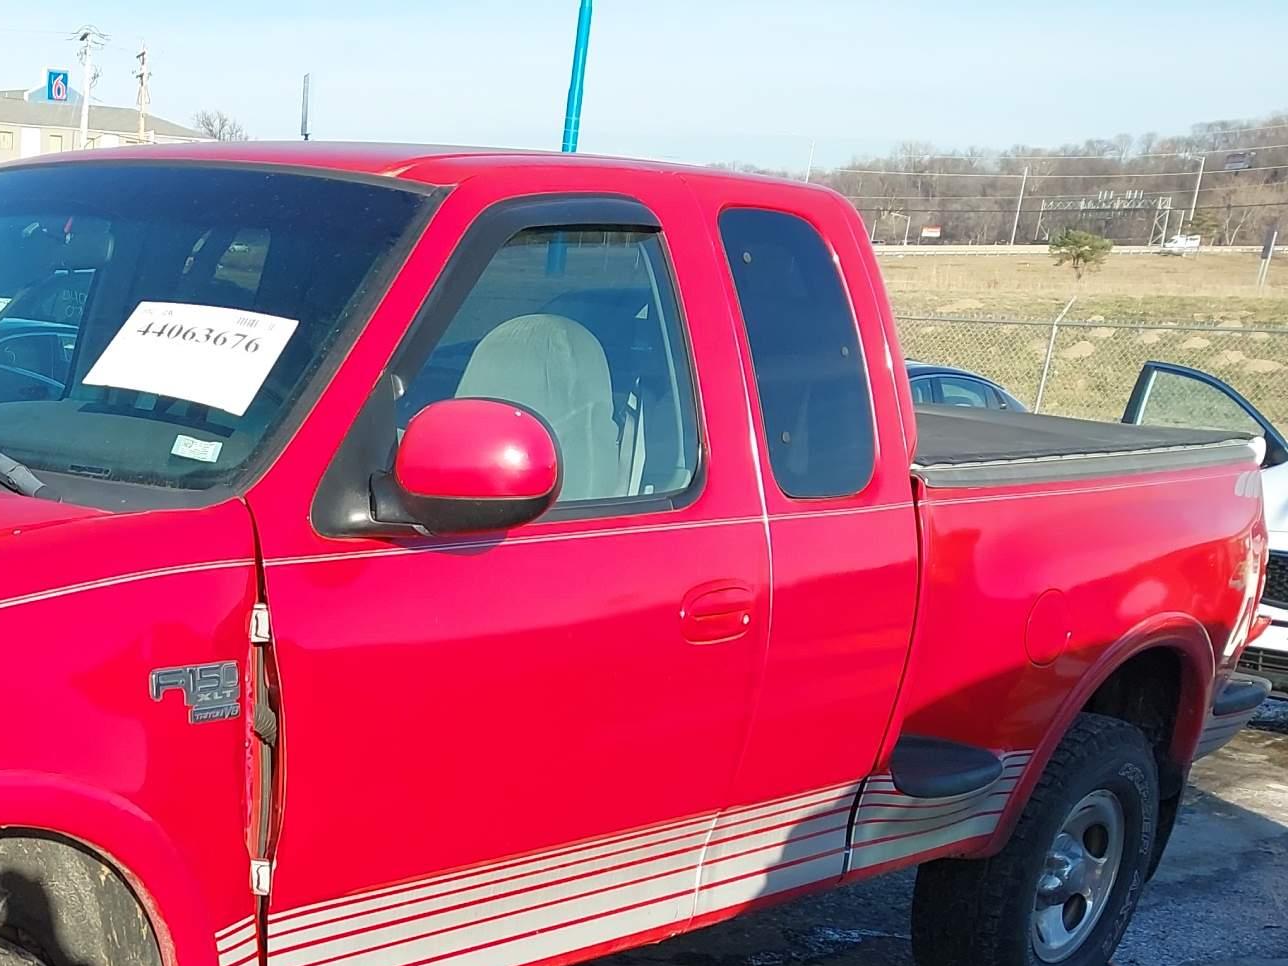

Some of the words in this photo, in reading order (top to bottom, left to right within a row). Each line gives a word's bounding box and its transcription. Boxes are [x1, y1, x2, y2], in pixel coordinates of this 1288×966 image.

[52, 73, 66, 100] 6
[136, 321, 261, 353] 44063676
[198, 690, 234, 702] XLT
